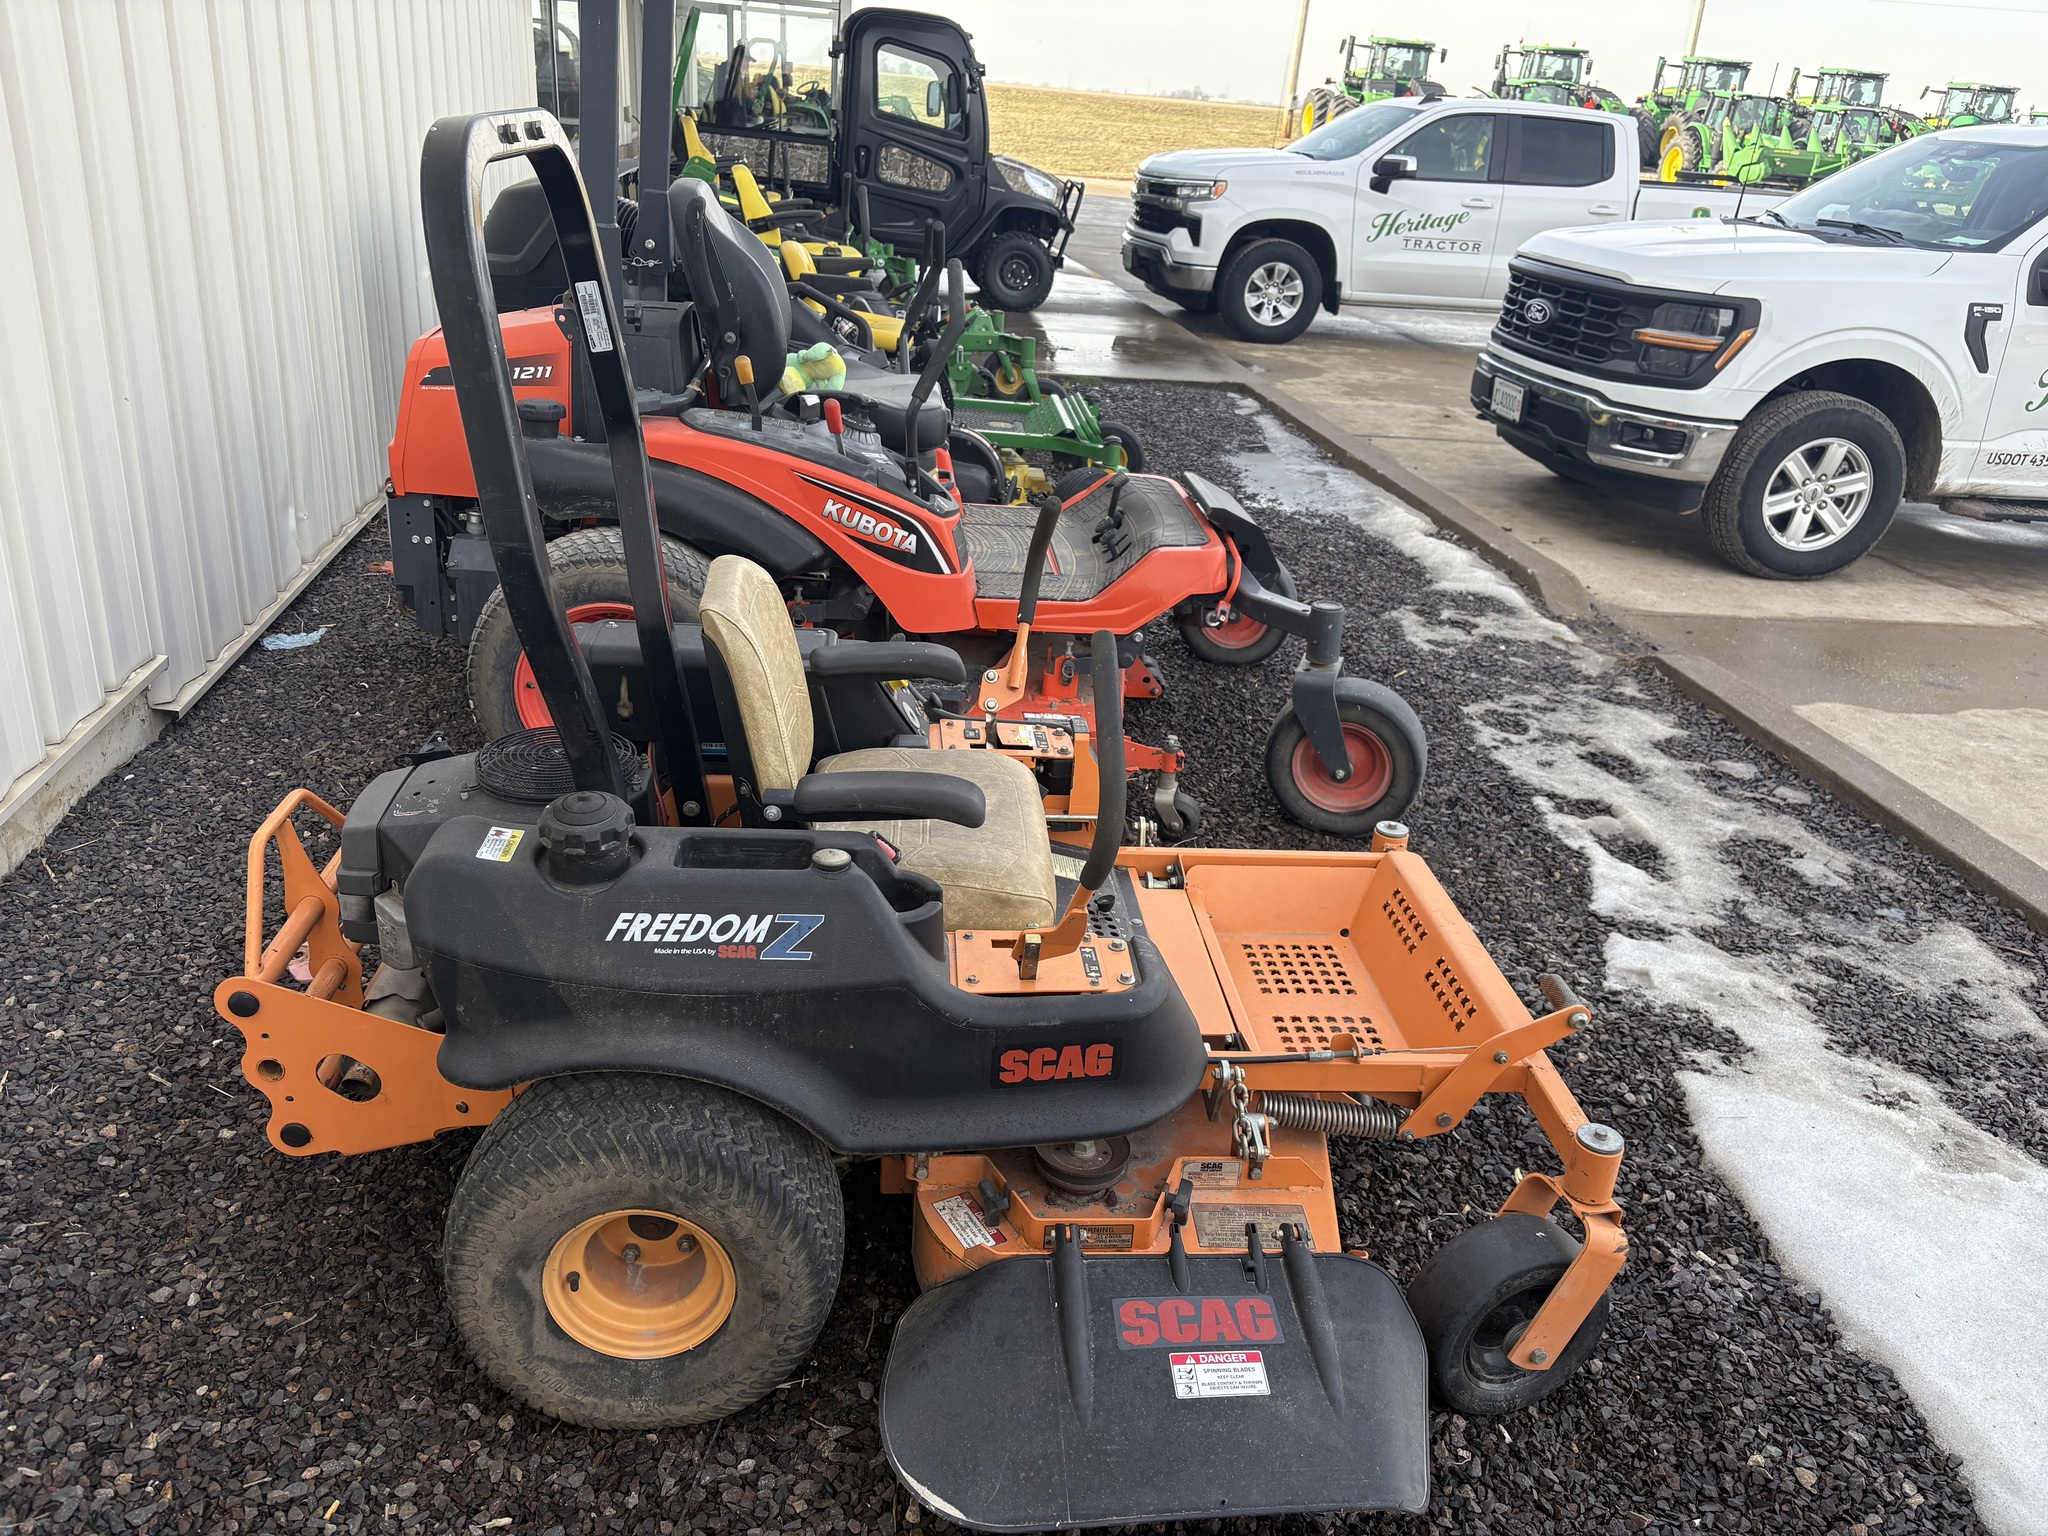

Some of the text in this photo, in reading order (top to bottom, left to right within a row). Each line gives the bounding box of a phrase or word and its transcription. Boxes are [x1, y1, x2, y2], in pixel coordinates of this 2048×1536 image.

[1366, 209, 1472, 243] Heritage
[1403, 238, 1482, 252] TRACTOR
[1973, 306, 2002, 314] F-150
[512, 365, 553, 380] 1211
[1987, 452, 2030, 466] USDOT
[821, 498, 918, 555] KUBOTA
[605, 912, 825, 961] FREEDOM Z
[653, 947, 673, 955] Made
[681, 947, 692, 955] the
[707, 948, 716, 956] by
[718, 945, 757, 959] SCAG
[999, 1043, 1114, 1083] SCAG
[1119, 1298, 1278, 1346] SCAG
[1199, 1353, 1247, 1364] DANGER
